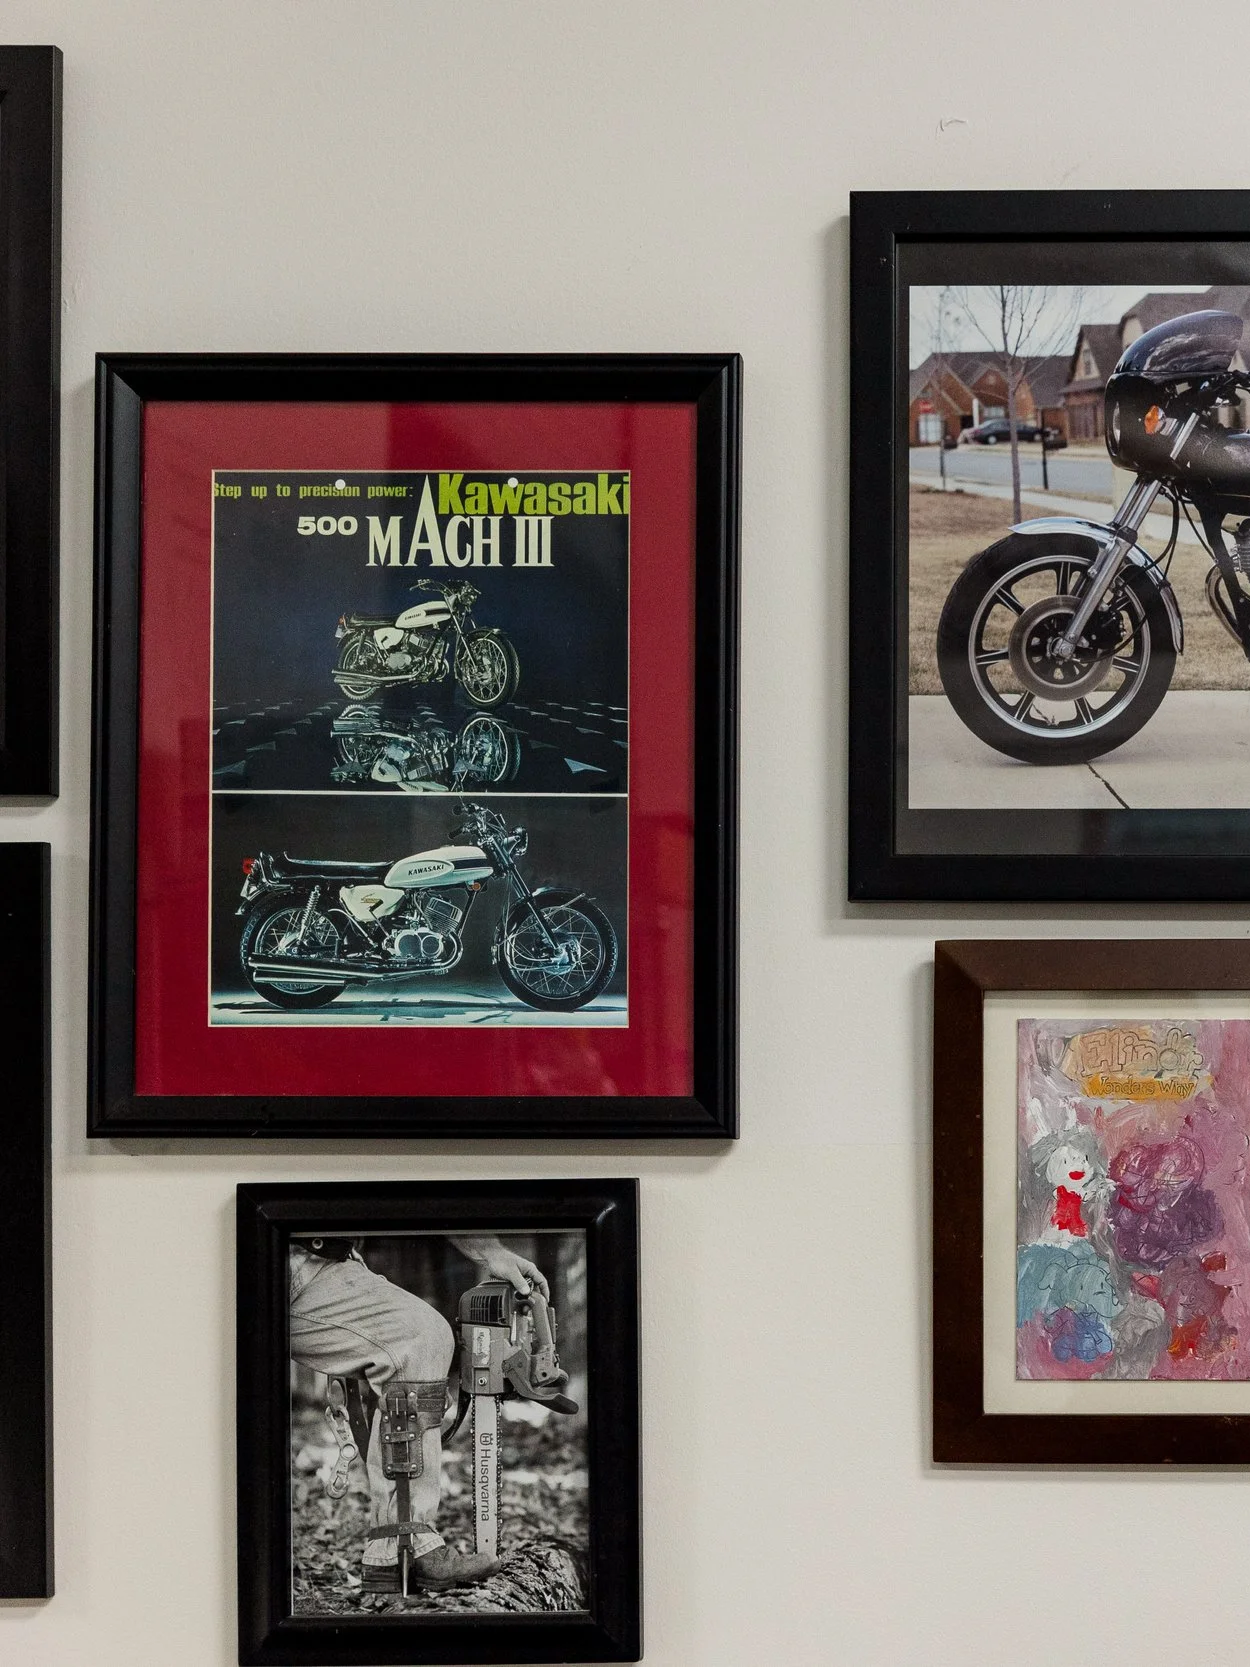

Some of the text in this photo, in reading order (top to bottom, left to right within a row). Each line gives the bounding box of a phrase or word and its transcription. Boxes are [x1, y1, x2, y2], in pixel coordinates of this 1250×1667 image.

[212, 483, 414, 499] Step up to precision power:
[438, 473, 630, 515] Kawasaki
[297, 474, 555, 568] 500 MACH III
[408, 864, 445, 876] KAWASAKI
[479, 1448, 491, 1521] Husqvarna
